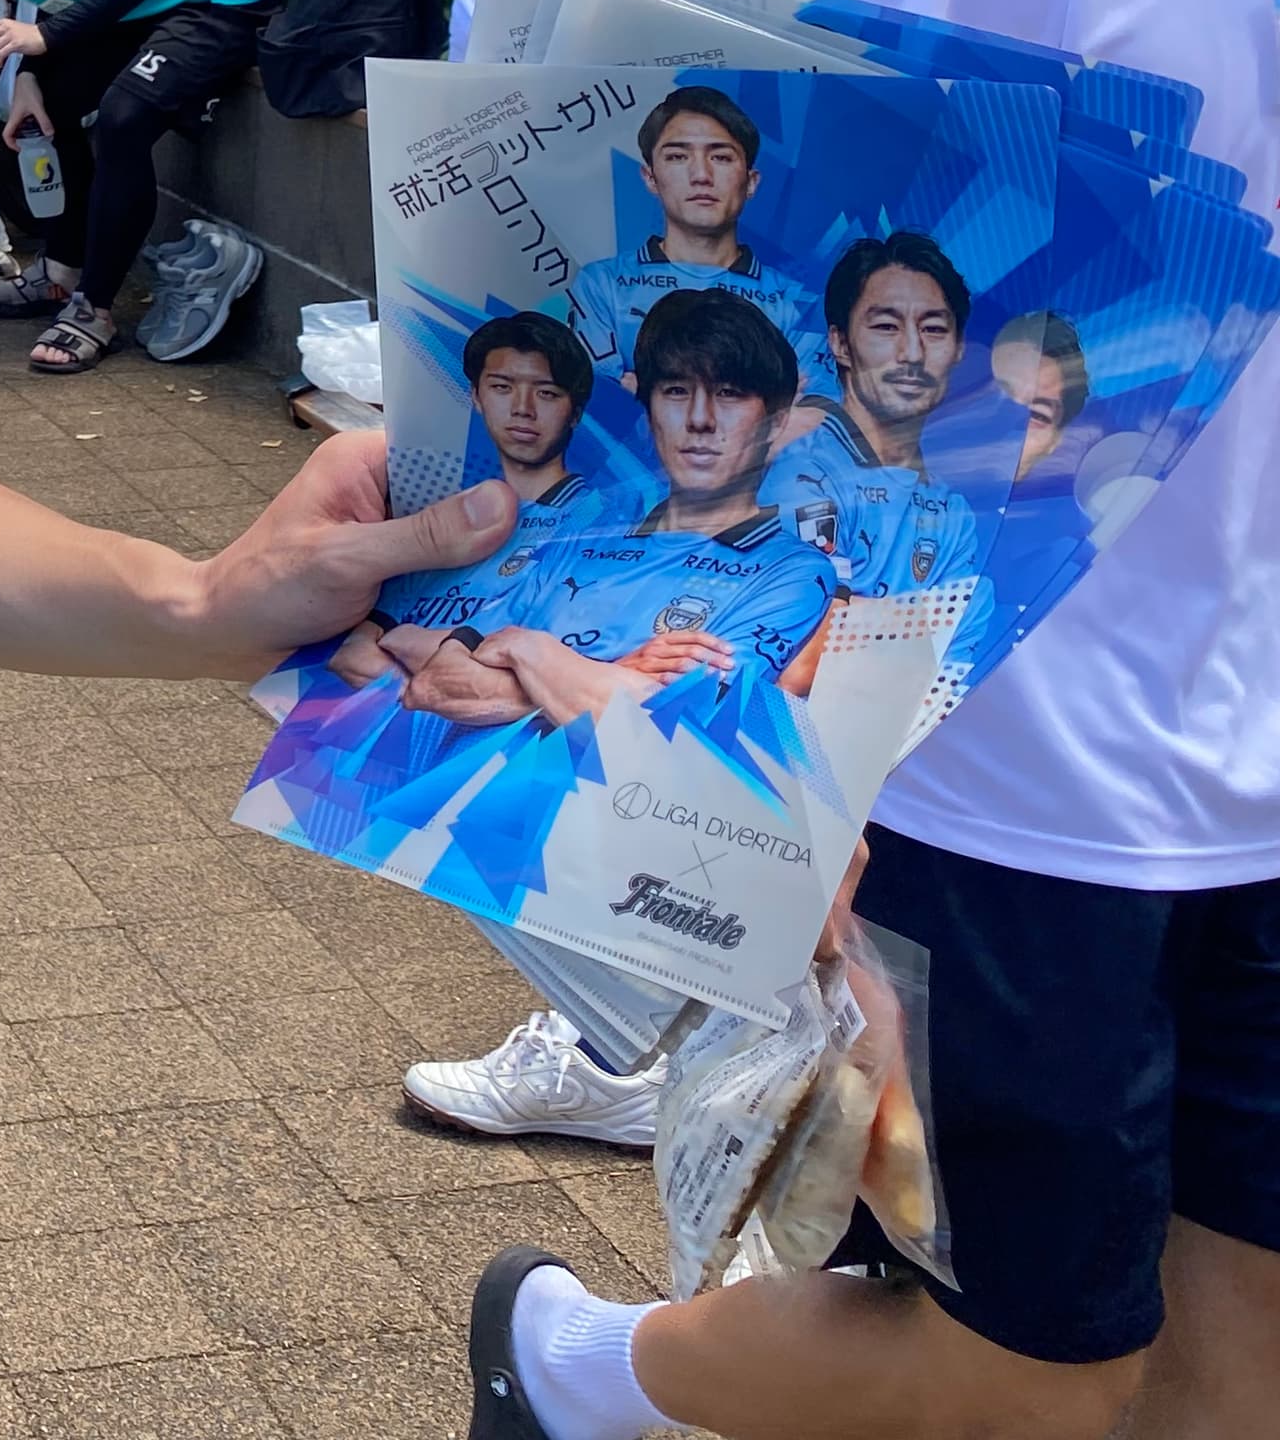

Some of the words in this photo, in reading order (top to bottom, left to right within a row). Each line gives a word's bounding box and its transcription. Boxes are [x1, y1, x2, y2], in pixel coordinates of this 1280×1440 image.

[406, 123, 463, 156] FOOTBALL
[464, 90, 524, 126] TOGETHER
[616, 274, 679, 289] ANKER
[608, 872, 747, 950] Frontale
[667, 885, 718, 908] KAWASAKI
